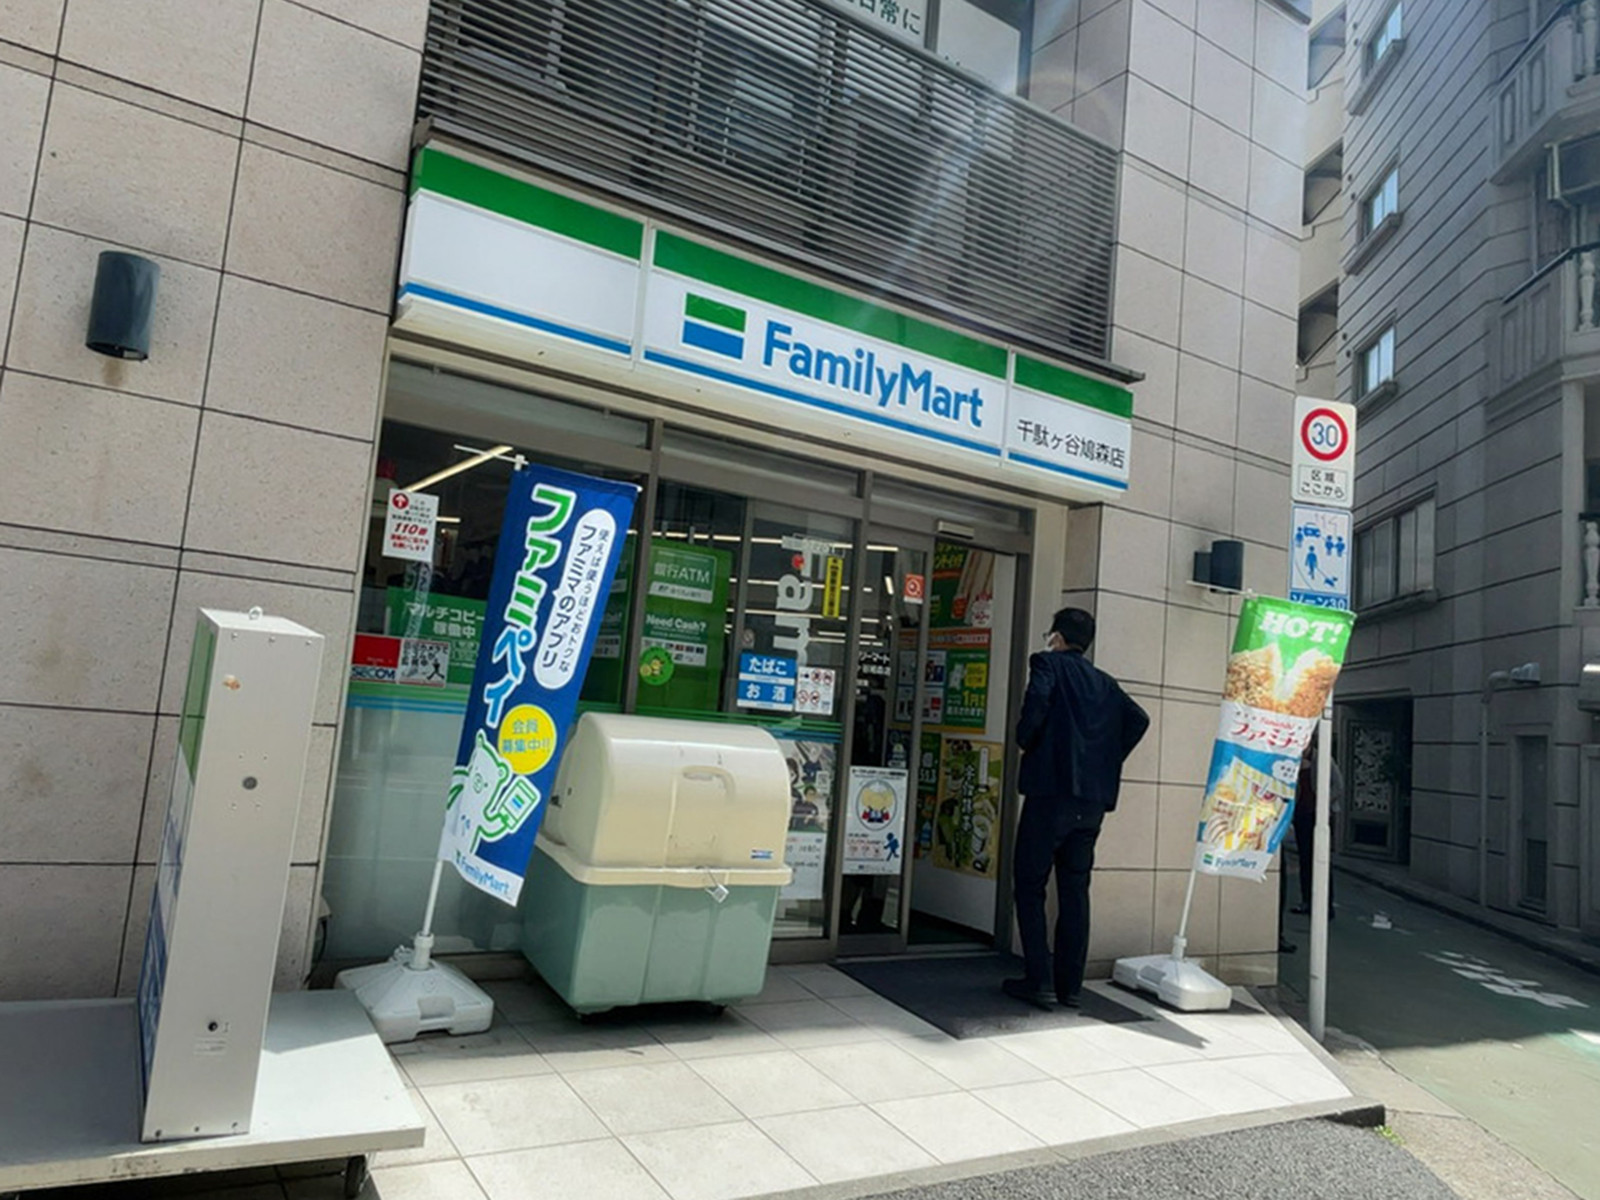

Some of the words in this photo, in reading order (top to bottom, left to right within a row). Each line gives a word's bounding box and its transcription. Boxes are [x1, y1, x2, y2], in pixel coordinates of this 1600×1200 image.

[762, 319, 984, 428] FamilyMart
[1311, 421, 1339, 448] 30
[1301, 481, 1345, 499] ここから
[1311, 469, 1335, 484] 区域
[483, 482, 577, 729] ファミペイ
[542, 524, 597, 668] ファミマのアプリ
[646, 613, 674, 628] Need
[1258, 610, 1345, 644] HOT!
[748, 656, 788, 676] たばこ
